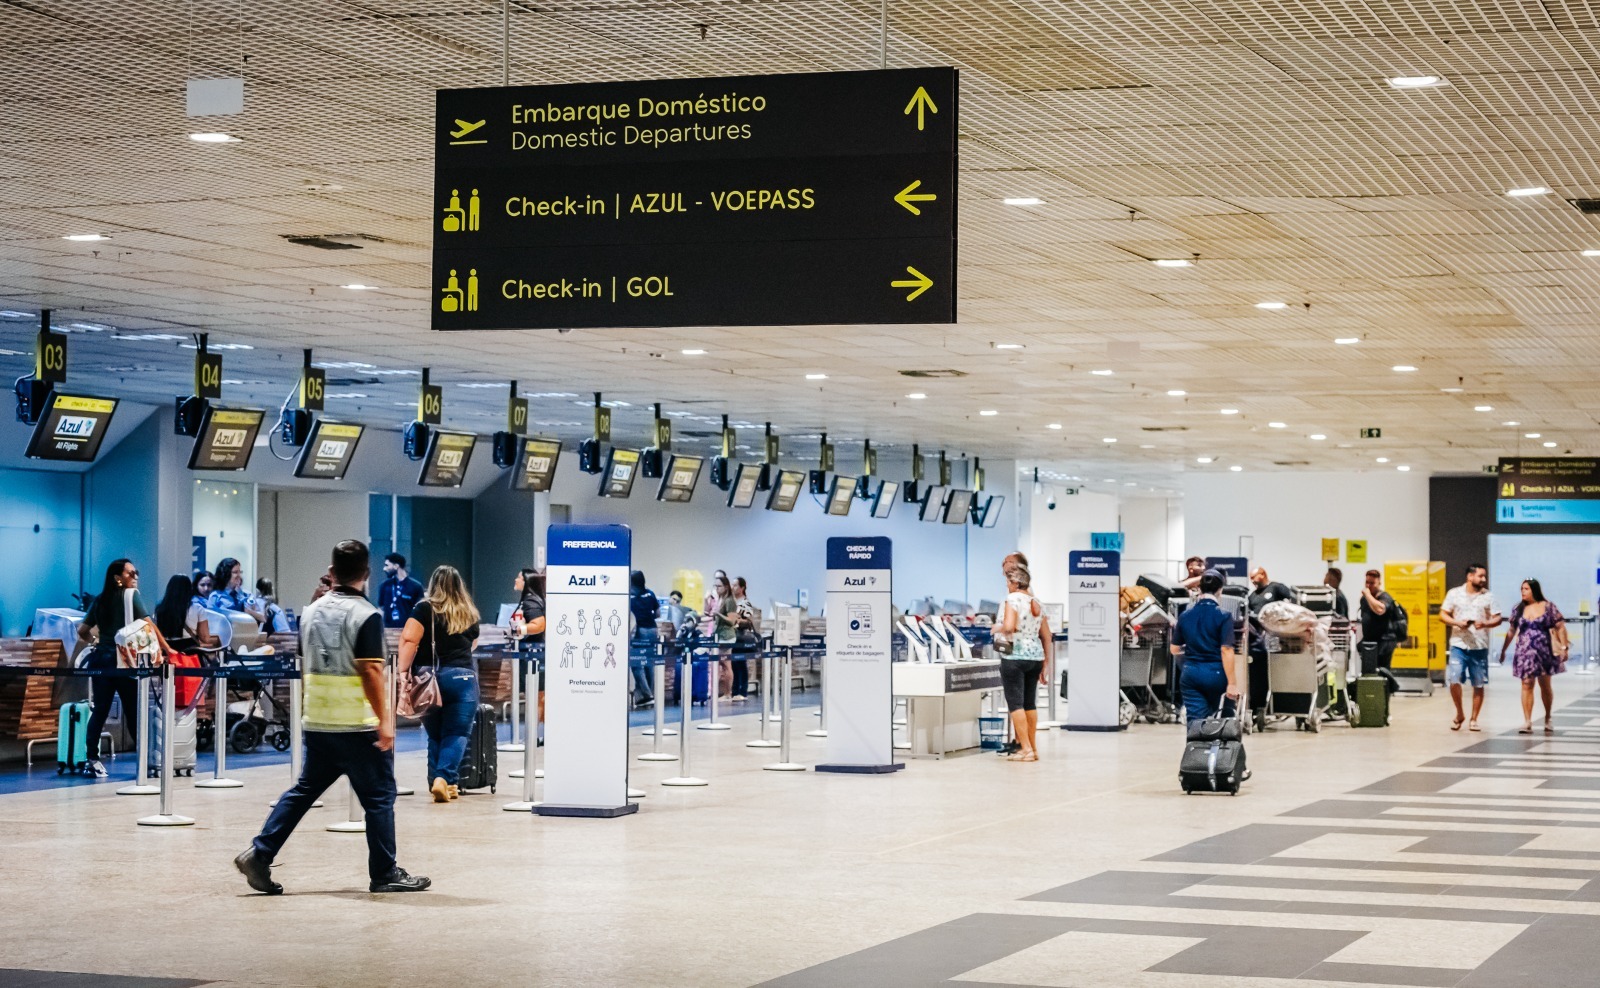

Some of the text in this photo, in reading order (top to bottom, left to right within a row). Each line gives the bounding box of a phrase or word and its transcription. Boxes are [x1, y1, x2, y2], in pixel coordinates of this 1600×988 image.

[512, 92, 767, 125] Embarque Doméstico
[512, 122, 752, 150] Domestic Departures
[505, 194, 606, 217] Check-in
[630, 192, 687, 213] AZUL
[711, 188, 816, 211] VOEPASS
[501, 277, 602, 300] Check-in
[626, 276, 674, 297] GOL
[44, 343, 64, 371] 03
[202, 363, 219, 388] 04
[307, 376, 322, 400] 05
[424, 393, 440, 416] 06
[57, 418, 84, 434] Azul
[514, 406, 527, 427] 07
[600, 414, 610, 434] 08
[214, 431, 236, 445] Azul
[660, 426, 670, 444] 09
[319, 443, 339, 456] Azul
[562, 540, 617, 549] PREFERENCIAL
[849, 551, 872, 560] RÁPIDO
[568, 574, 596, 587] Azul
[843, 576, 866, 586] Azul
[1080, 581, 1098, 589] Azul
